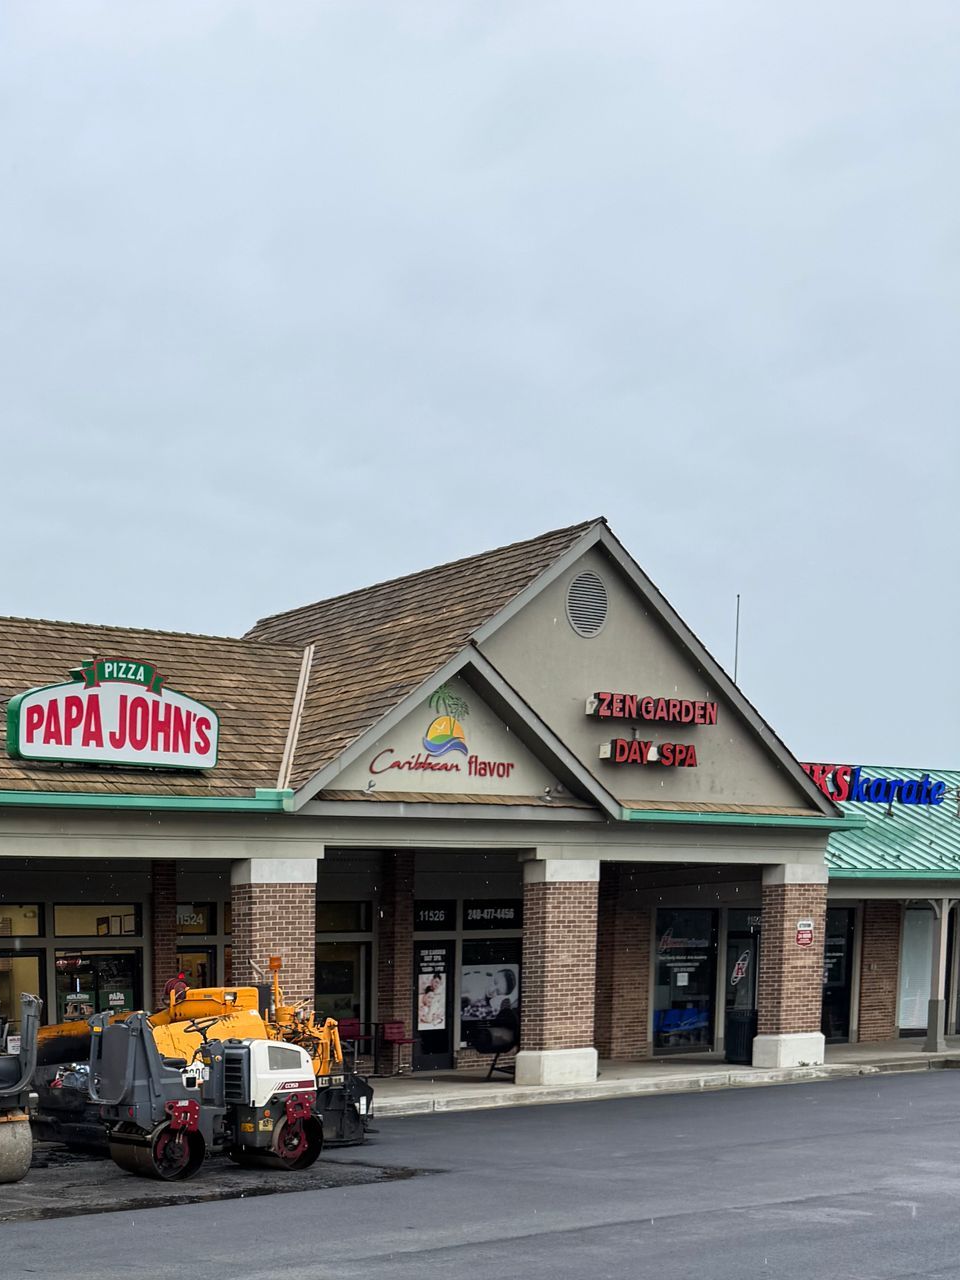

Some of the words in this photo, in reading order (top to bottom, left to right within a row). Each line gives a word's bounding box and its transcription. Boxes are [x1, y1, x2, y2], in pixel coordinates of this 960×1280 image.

[104, 663, 145, 682] PIZZA
[598, 692, 638, 719] ZEN
[641, 696, 718, 726] GARDEN
[26, 694, 104, 748] PAPA
[109, 695, 212, 755] JOHN'S
[368, 748, 462, 775] Caribbean
[467, 755, 515, 778] flavor
[615, 738, 652, 765] DAY
[661, 743, 697, 768] SPA
[419, 910, 446, 921] 11526
